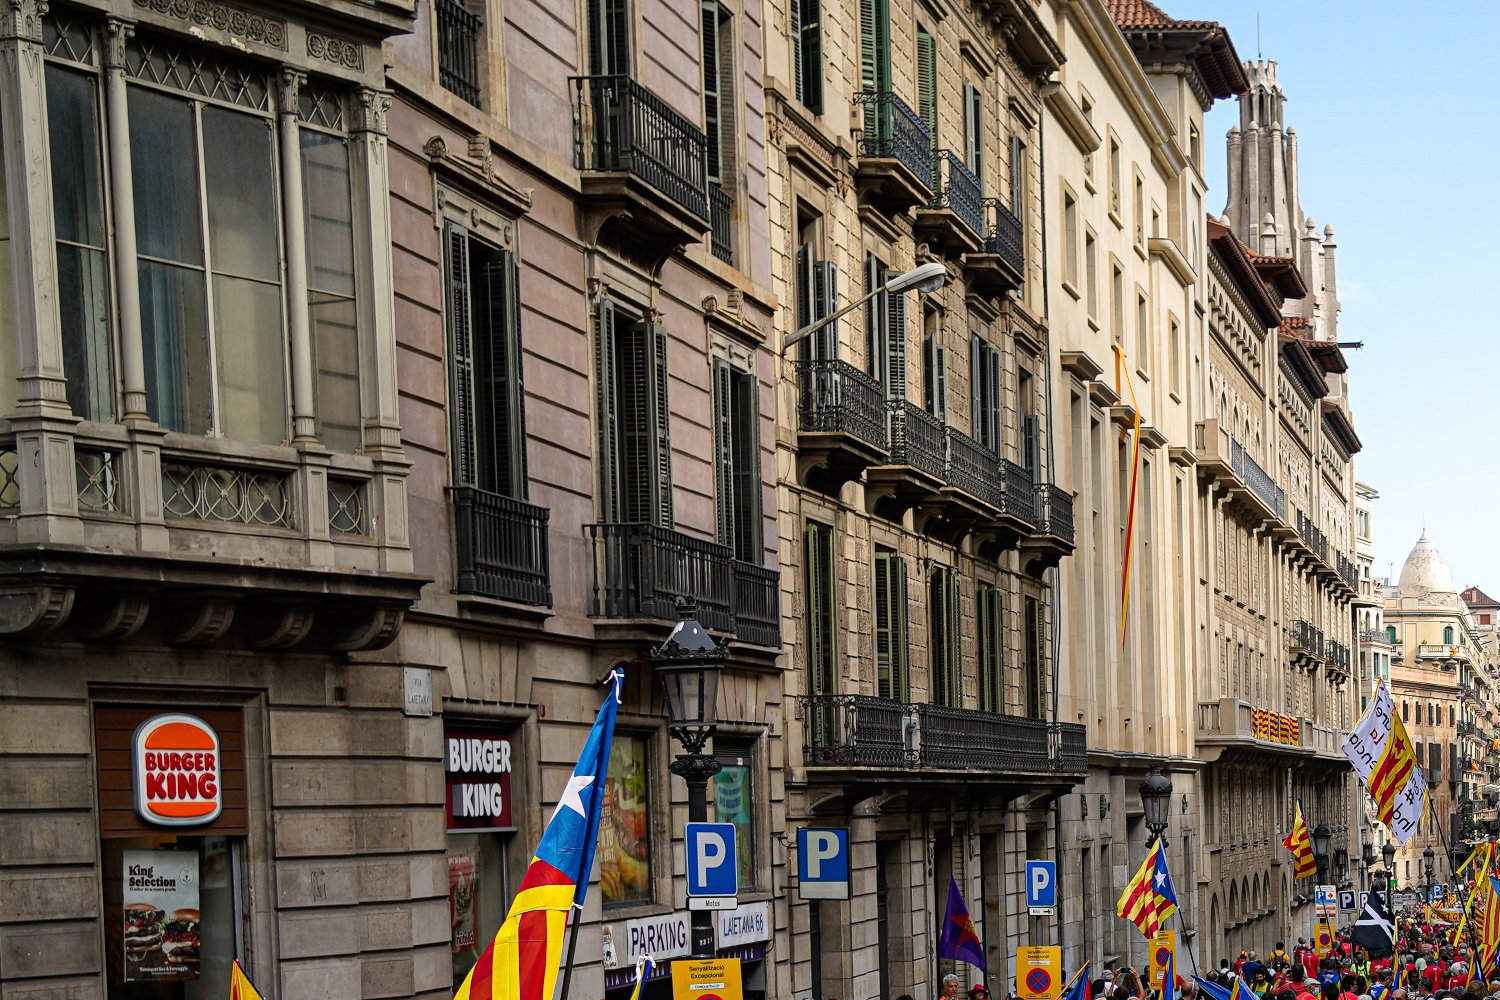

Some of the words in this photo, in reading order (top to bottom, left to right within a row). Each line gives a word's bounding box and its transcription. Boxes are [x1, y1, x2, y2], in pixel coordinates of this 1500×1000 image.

[413, 678, 422, 687] VIA
[145, 753, 215, 771] BURGER
[449, 738, 511, 774] BURGER
[146, 773, 217, 799] KING
[461, 783, 503, 817] KING
[697, 832, 726, 887] P
[807, 831, 840, 878] P
[129, 864, 154, 878] King
[129, 876, 176, 887] Selection
[1032, 867, 1049, 901] P
[1342, 893, 1352, 908] P
[723, 916, 754, 937] LAIETANA
[755, 913, 764, 932] 66
[631, 921, 686, 956] PARKING
[606, 973, 619, 987] VIA
[688, 965, 725, 973] Senyalització
